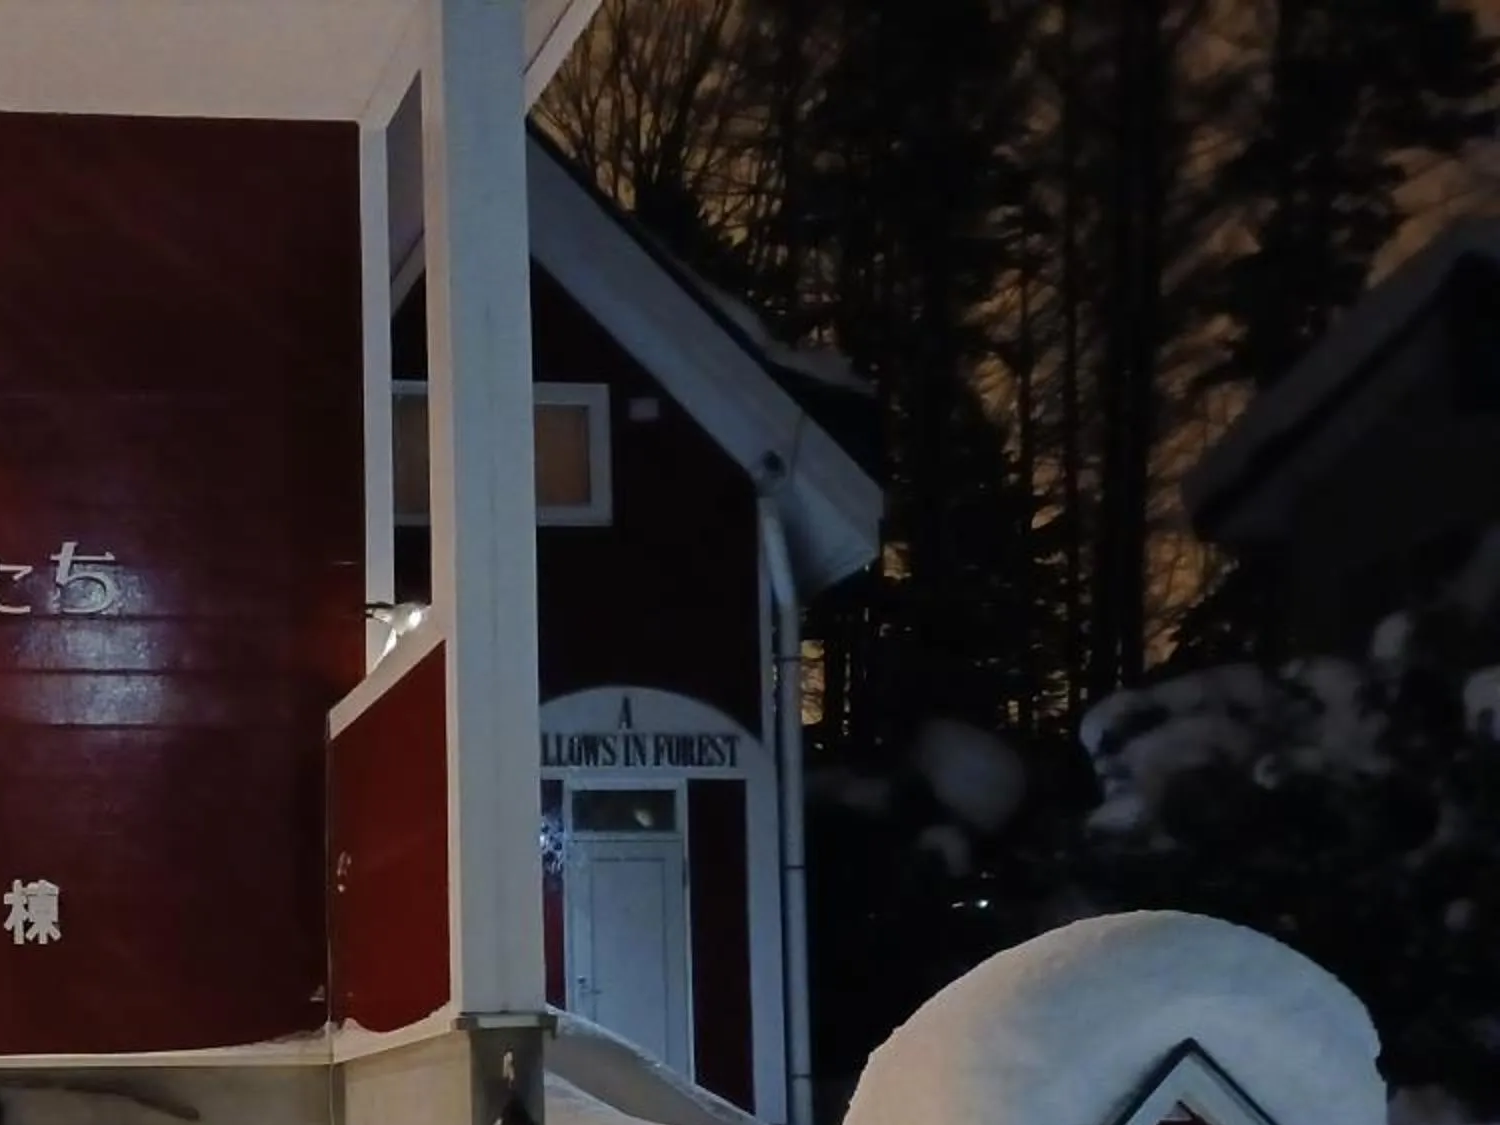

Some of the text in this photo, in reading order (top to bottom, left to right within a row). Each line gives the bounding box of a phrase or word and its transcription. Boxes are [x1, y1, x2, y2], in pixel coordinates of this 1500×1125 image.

[618, 696, 633, 729] A
[622, 733, 647, 767] IN
[652, 734, 739, 768] FOREST
